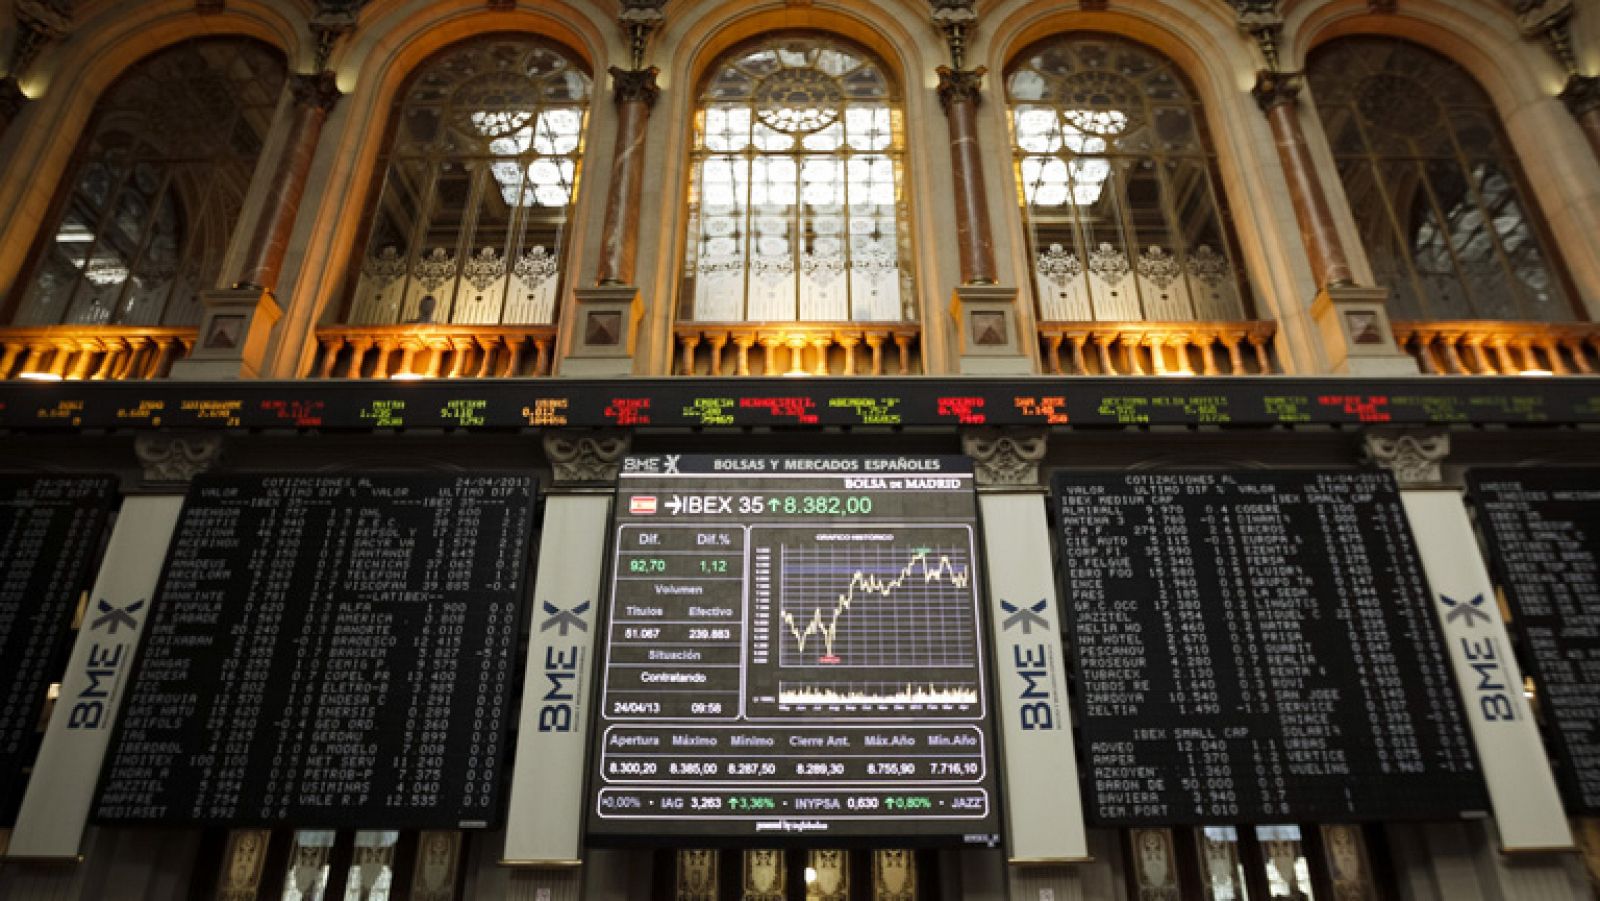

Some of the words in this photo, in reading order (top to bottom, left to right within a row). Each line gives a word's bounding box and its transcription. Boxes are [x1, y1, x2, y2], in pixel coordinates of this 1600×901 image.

[623, 458, 659, 471] BME
[714, 459, 765, 470] BOLSAS
[770, 459, 779, 470] Y
[785, 459, 859, 470] MERCADOS
[864, 456, 941, 470] ESPAÑOLES
[845, 479, 886, 489] BOLSA
[905, 479, 961, 489] MADRID
[683, 496, 732, 513] IBEX
[738, 496, 764, 513] 35
[783, 496, 872, 515] 8.382,00
[639, 534, 660, 544] Dif.
[630, 560, 665, 573] 92,70
[700, 560, 727, 573] 1,12
[654, 584, 703, 594] Volumen
[688, 606, 733, 616] Efectivo
[648, 649, 701, 660] Situación
[640, 671, 707, 683] Contratando
[1460, 637, 1515, 720] BME
[67, 643, 124, 729] BME
[538, 646, 577, 732] BME
[1013, 644, 1053, 730] BME
[614, 703, 661, 713] 24/04/13
[609, 735, 660, 747] Apertura
[672, 734, 717, 746] Máximo
[790, 736, 823, 747] Cierre
[827, 736, 850, 746] Ant.
[463, 796, 488, 805] 0.0
[660, 797, 684, 808] IAG
[795, 797, 840, 808] INYPSA
